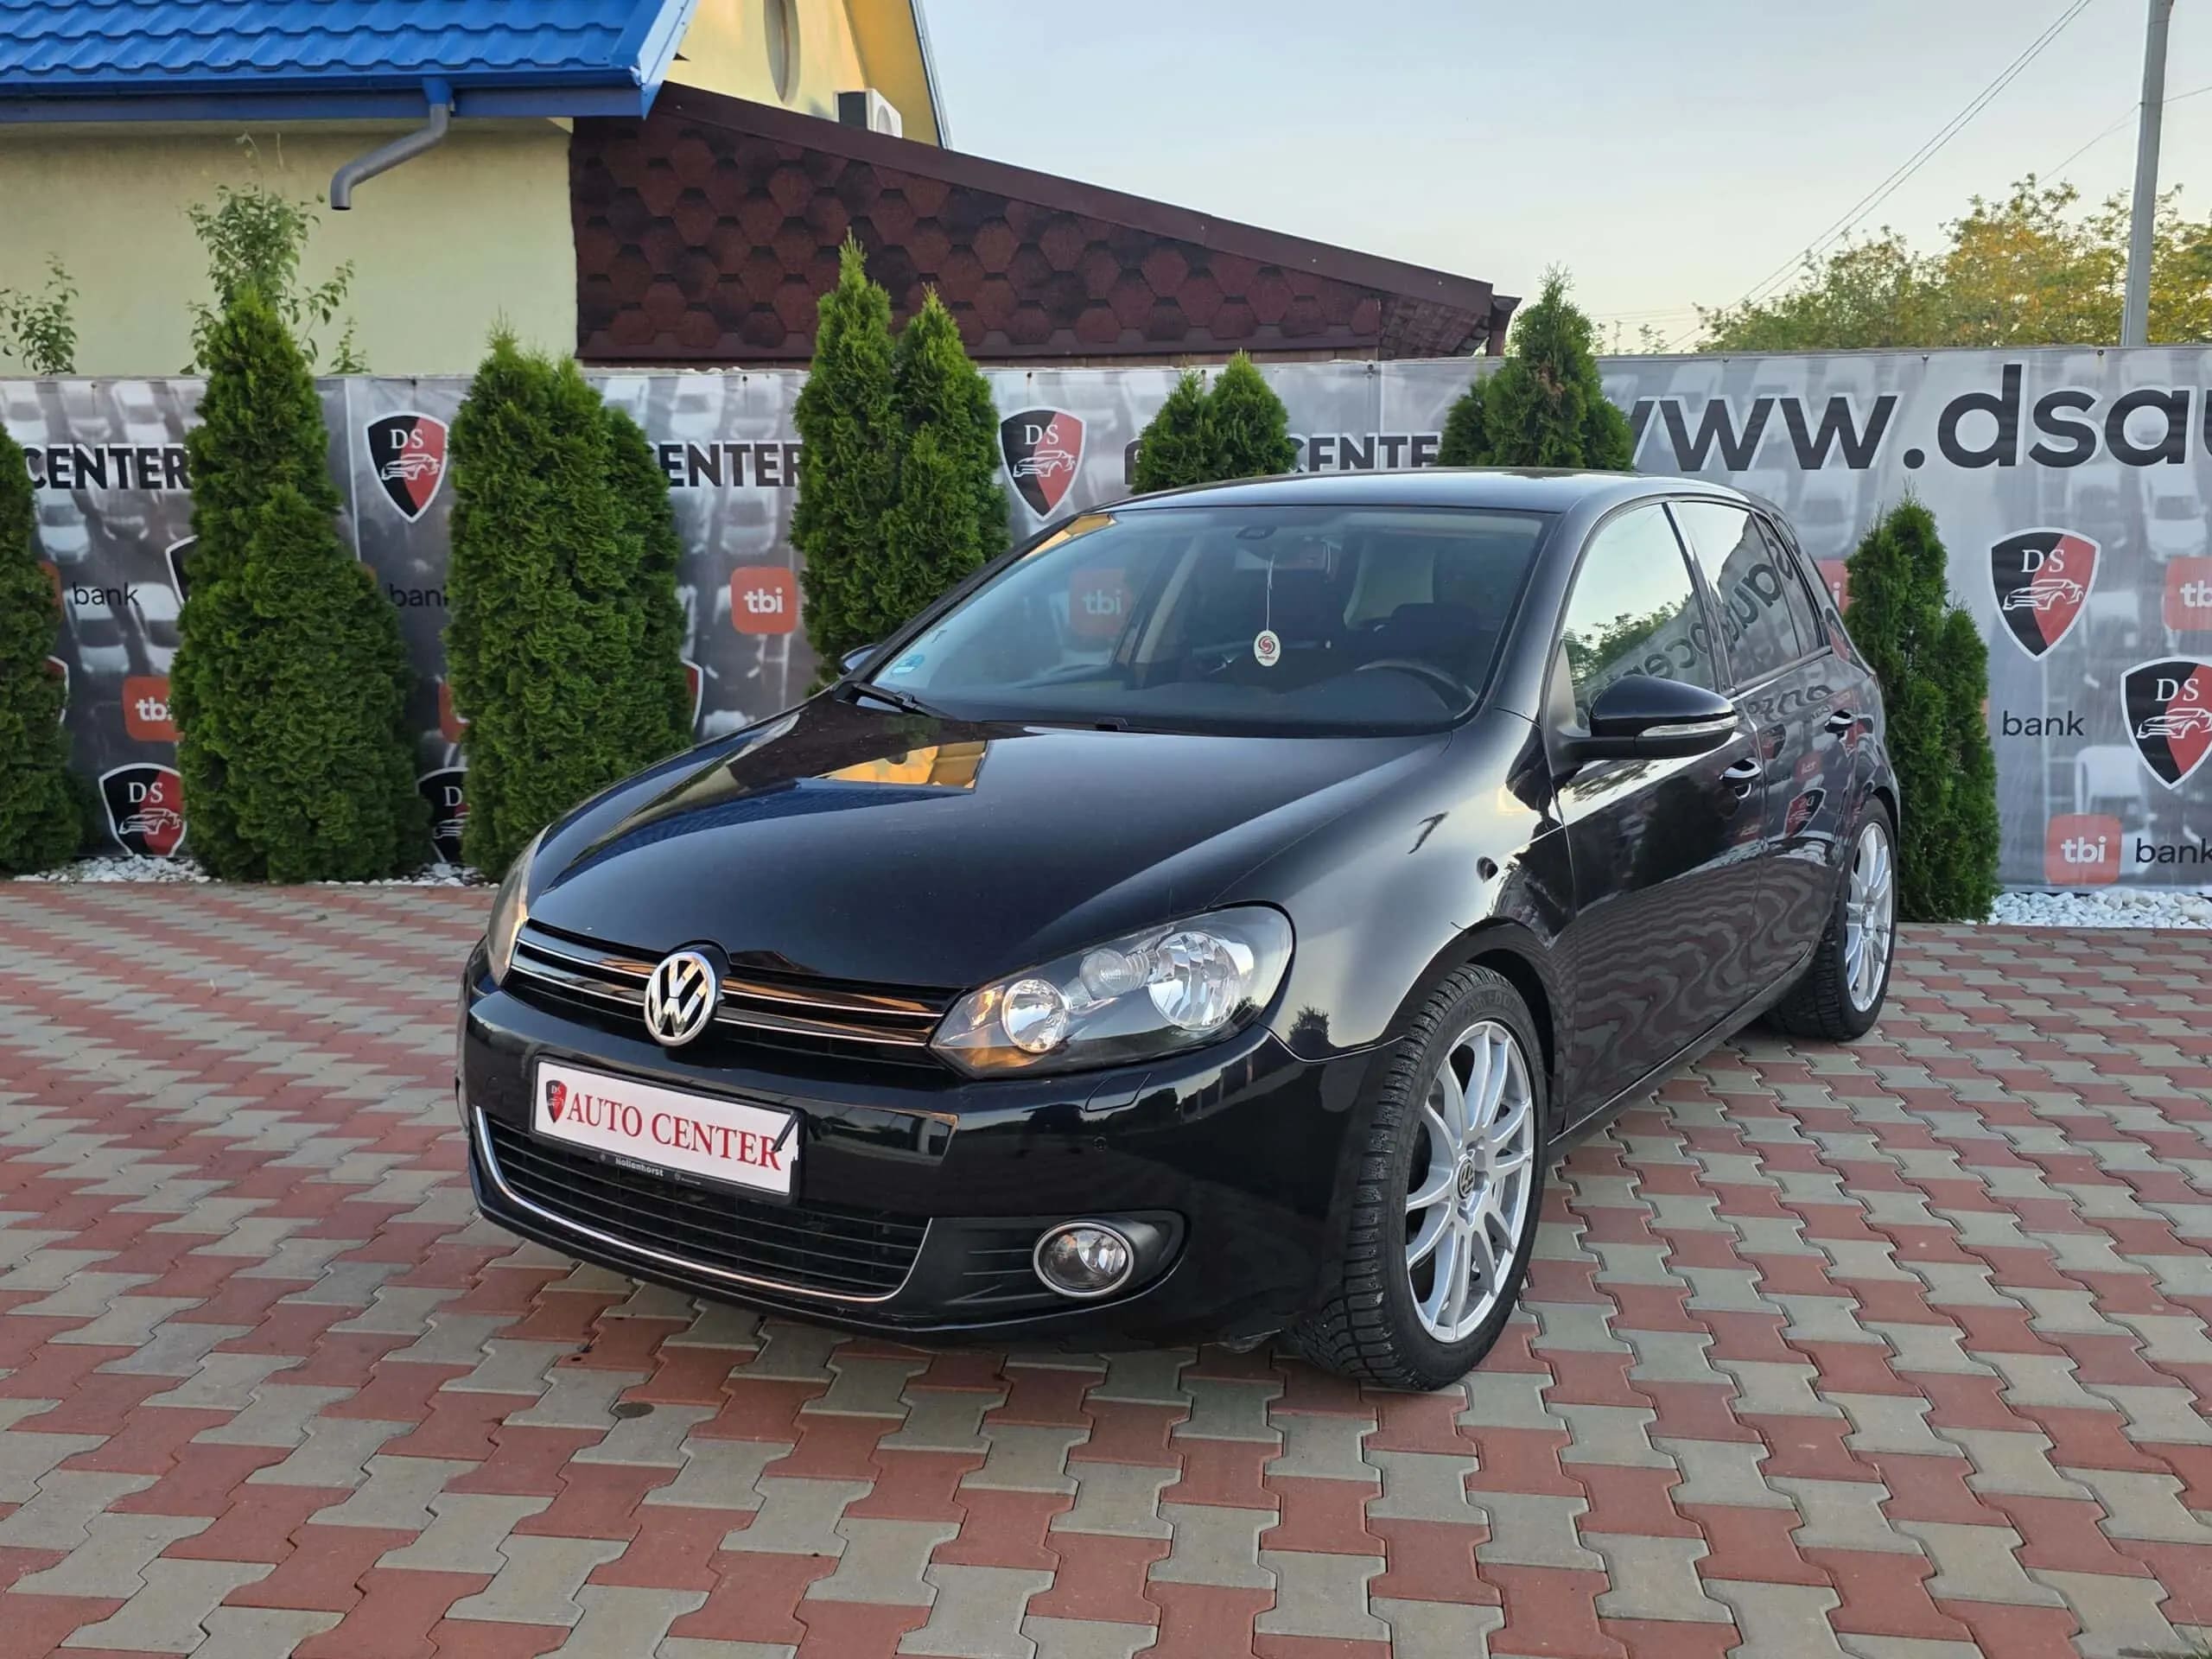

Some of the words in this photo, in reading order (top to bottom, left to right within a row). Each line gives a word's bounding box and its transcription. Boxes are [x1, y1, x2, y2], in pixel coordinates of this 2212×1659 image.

[1630, 364, 2212, 472] ww.dsa
[390, 429, 424, 449] DS
[1024, 424, 1059, 445] DS
[658, 442, 803, 487] ENTER
[1287, 435, 1439, 473] ENTE
[2021, 549, 2065, 573] DS
[73, 582, 138, 605] bank
[744, 587, 783, 613] tbi
[1082, 588, 1122, 615] tbi
[2180, 580, 2212, 607] tb
[2155, 677, 2199, 702] DS
[2002, 710, 2085, 736] bank
[128, 782, 164, 804] DS
[2061, 836, 2107, 863] tbi
[567, 1092, 643, 1138] AUTO
[652, 1112, 781, 1171] CENTER
